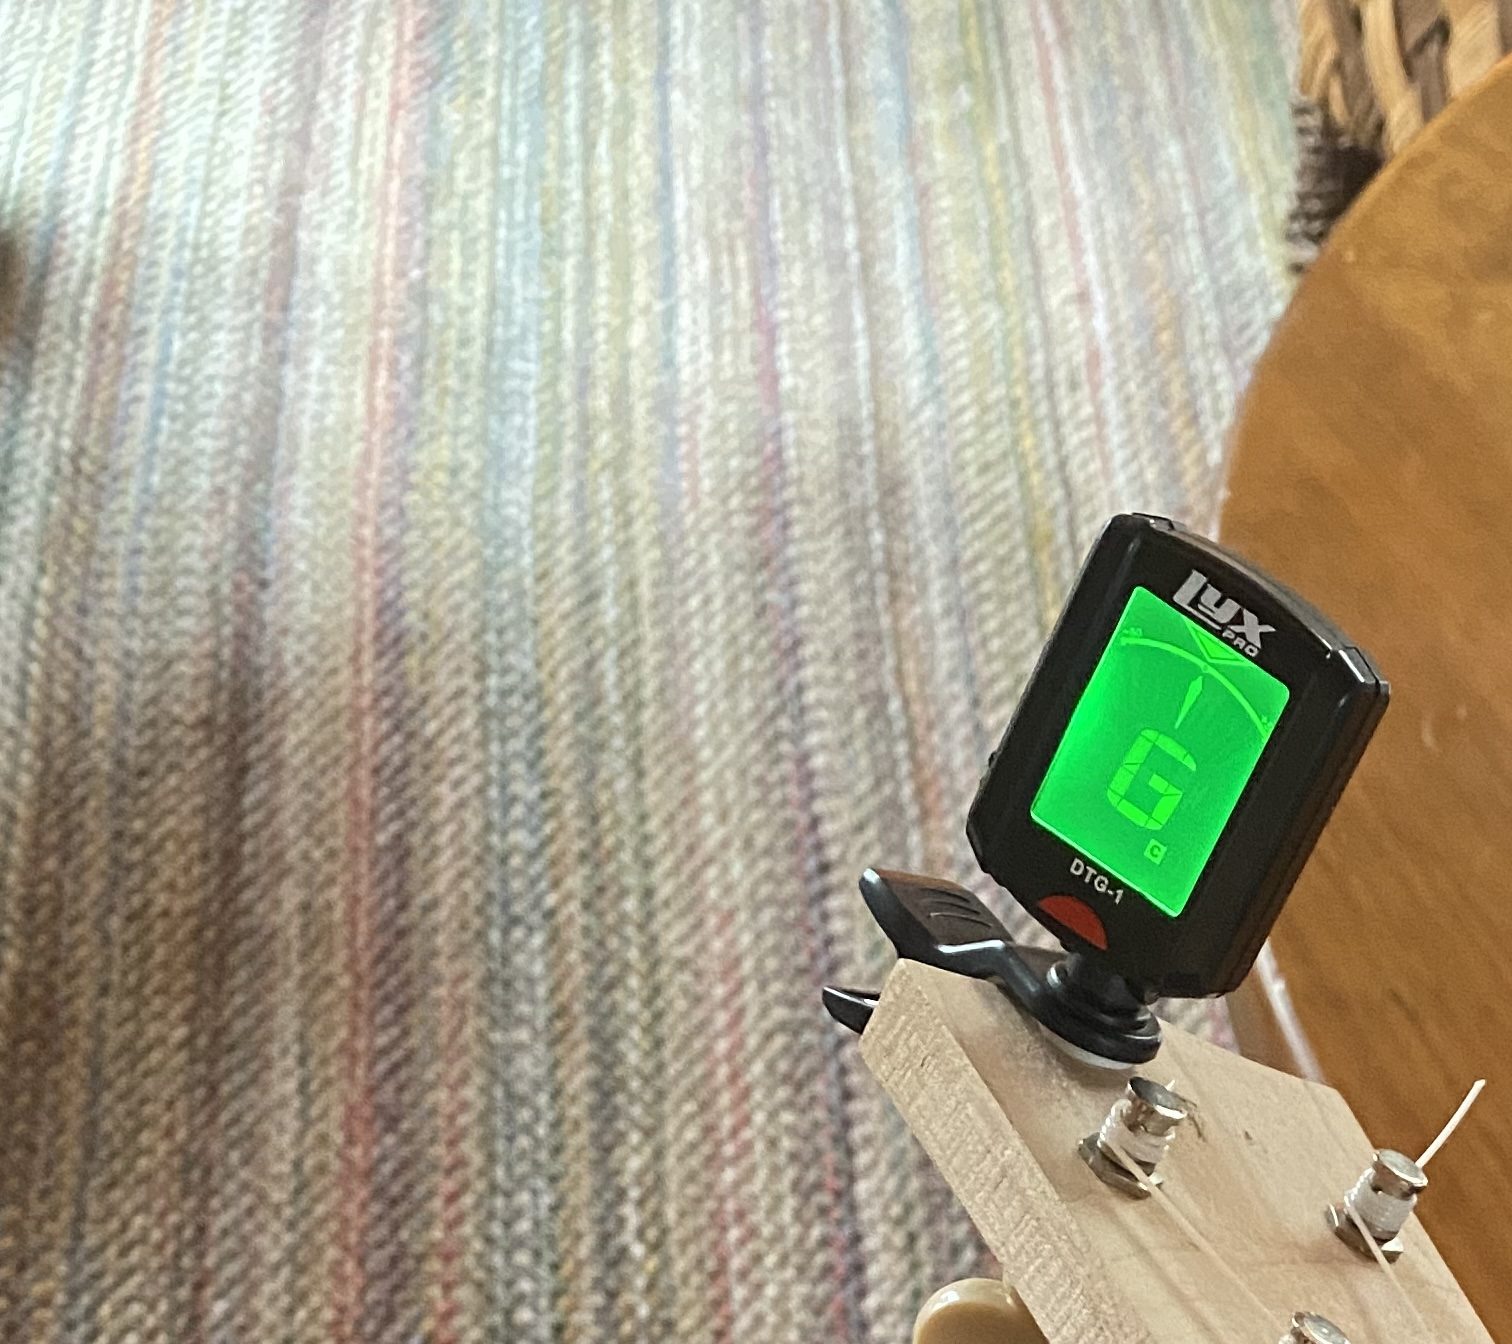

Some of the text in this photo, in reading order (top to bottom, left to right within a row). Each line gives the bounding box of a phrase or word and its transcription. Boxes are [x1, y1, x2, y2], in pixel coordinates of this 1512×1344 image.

[1222, 628, 1259, 657] PRO
[1107, 727, 1197, 830] G
[1069, 857, 1124, 904] DTG-1
